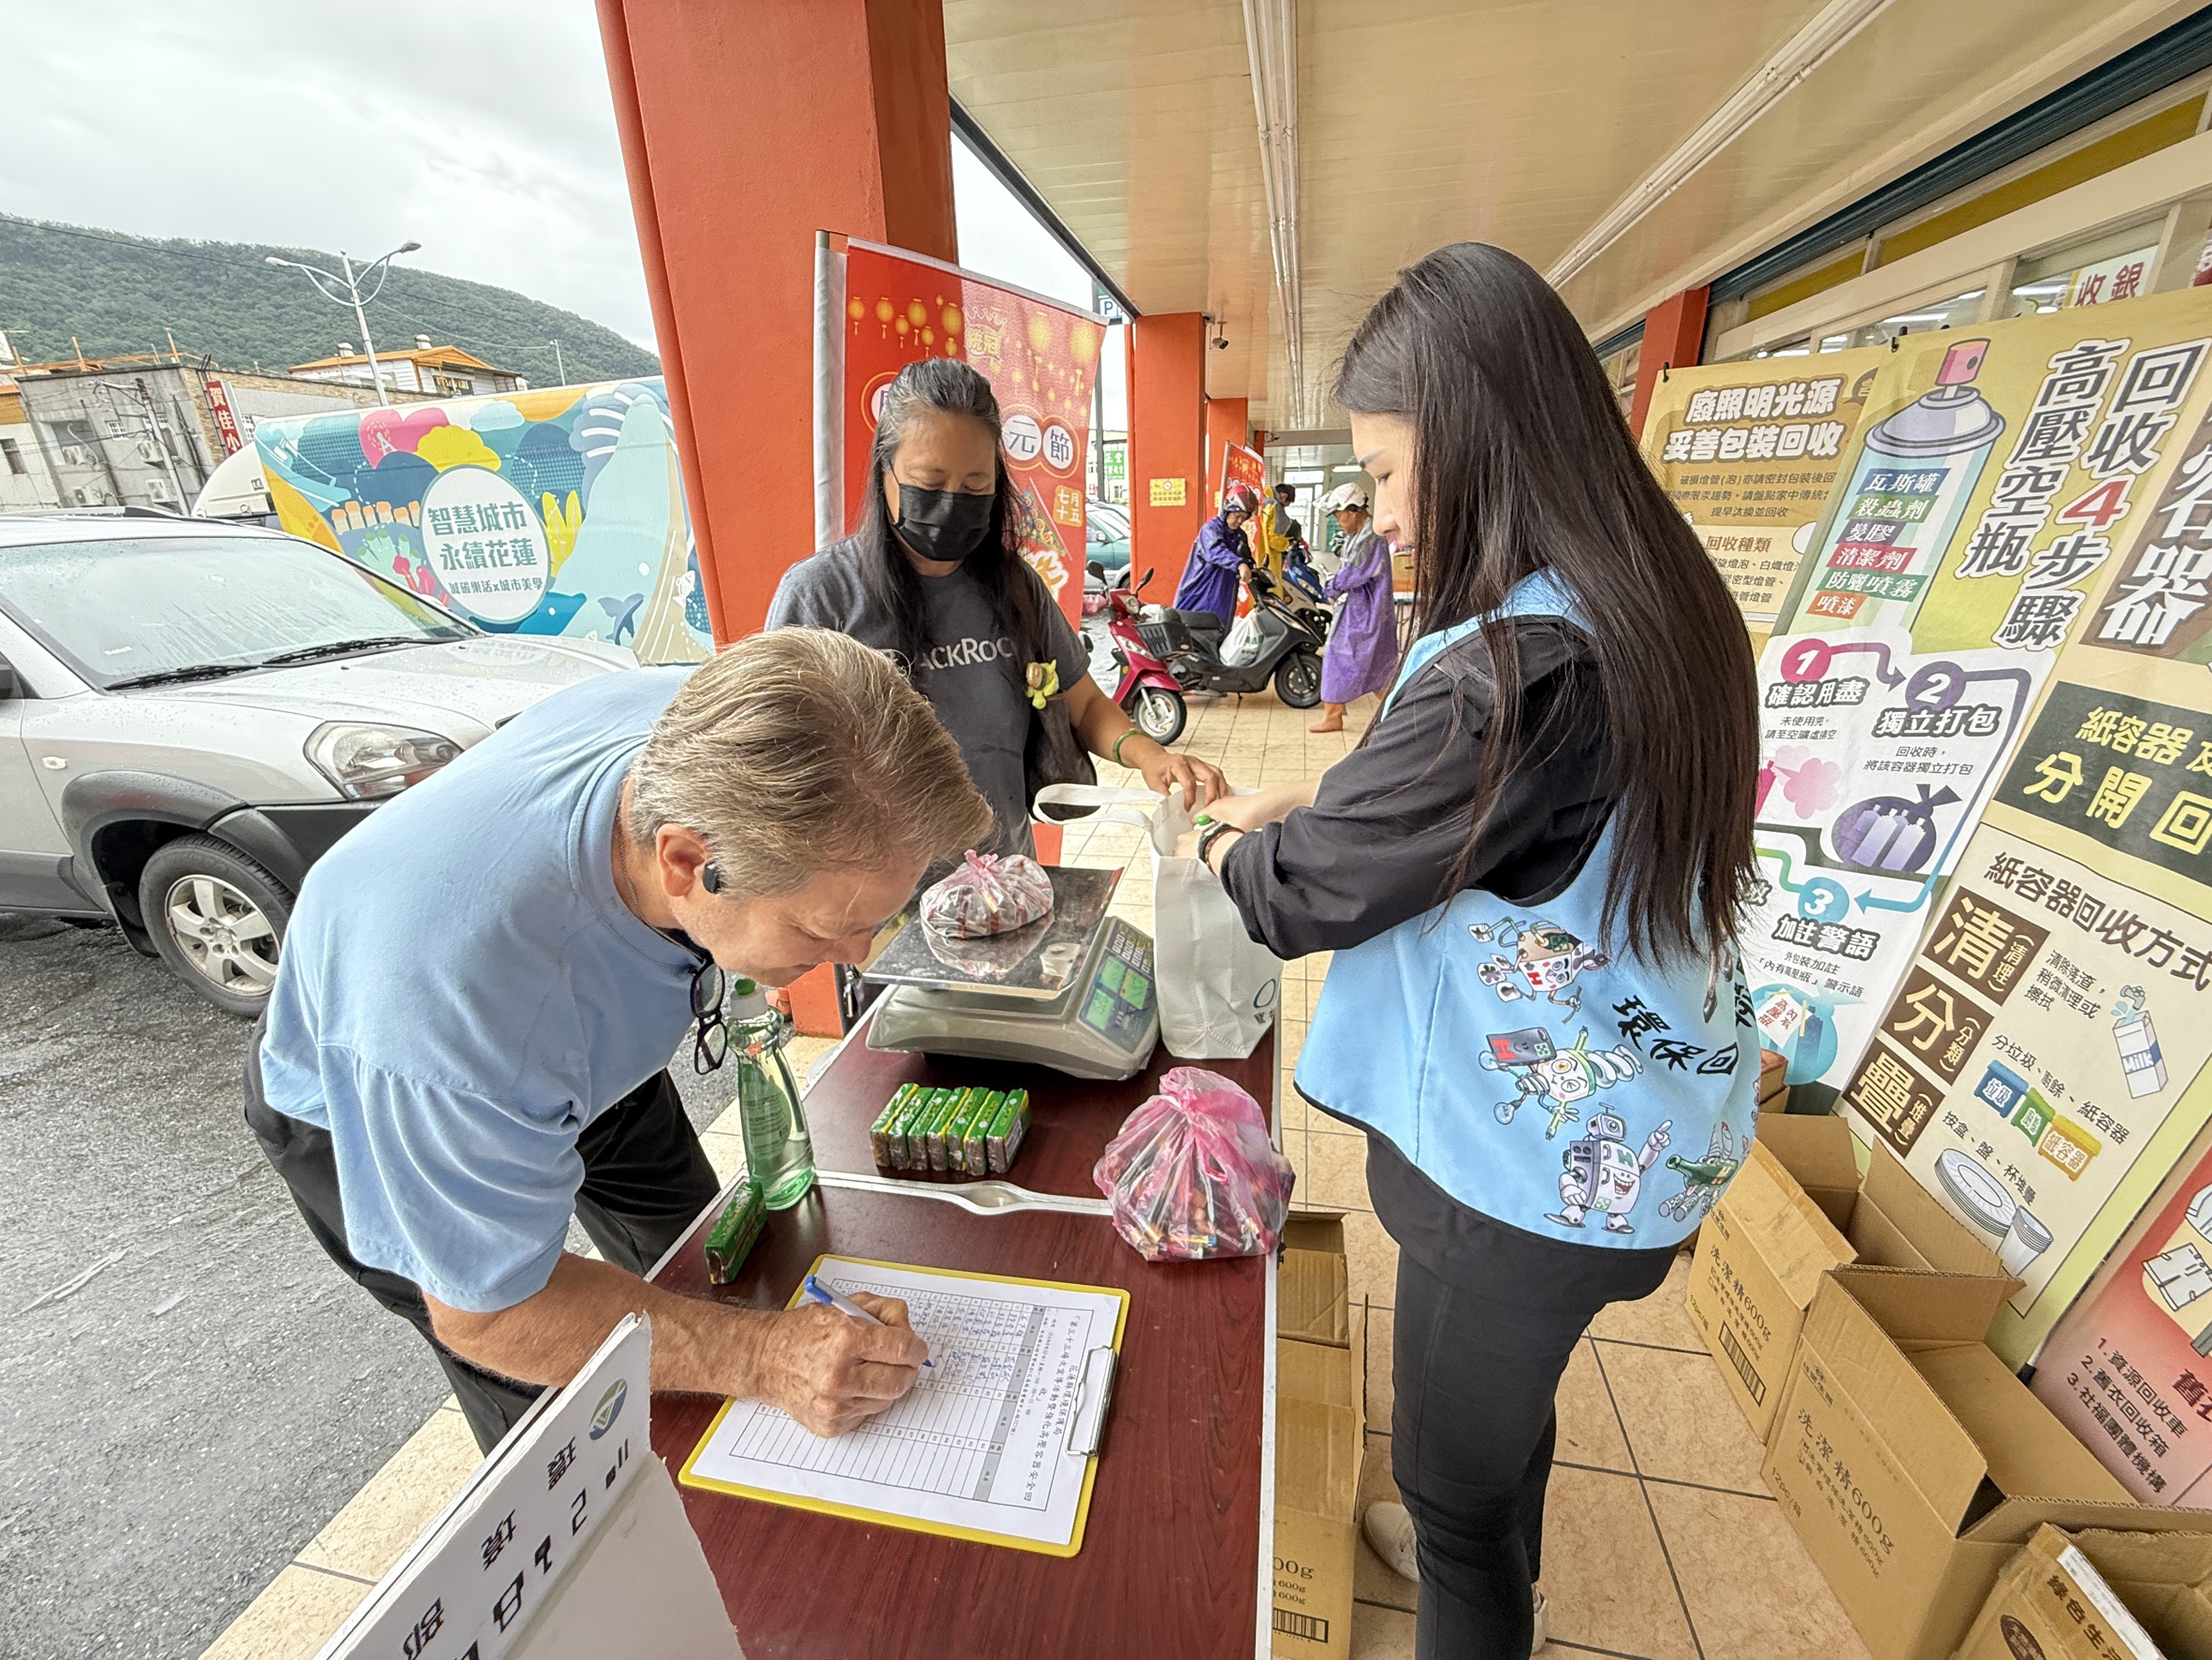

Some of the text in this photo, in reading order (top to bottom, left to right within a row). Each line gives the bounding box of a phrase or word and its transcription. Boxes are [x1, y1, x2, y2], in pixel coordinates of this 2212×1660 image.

[1104, 301, 1113, 315] P
[1685, 379, 1841, 422] 廢照明光源
[209, 386, 241, 451] 賀佳小
[1663, 422, 1845, 461] 妥善包裝回收
[1959, 339, 2130, 576] 高壓空瓶
[1864, 473, 1941, 494] 瓦斯罐
[2001, 341, 2205, 648] 回收4步驟
[428, 502, 528, 536] 智慧城市
[1855, 497, 1931, 520] 殺蟲劑
[1706, 535, 1772, 553] 回收種類
[1845, 522, 1896, 543] 髮膠
[440, 537, 538, 571] 永續花蓮
[1835, 546, 1909, 571] 清潔劑
[1825, 571, 1918, 598] 防曬噴霧
[1814, 594, 1857, 616] 噴漆
[1796, 649, 1820, 676] 1
[1767, 679, 1866, 706] 確認用盡
[1914, 673, 1952, 705] 2
[1875, 706, 2001, 735] 獨立打包
[1863, 760, 1973, 776] 將該容器獨立打包
[2022, 750, 2212, 855] 分開回
[1803, 888, 1834, 915] 3
[1983, 852, 2212, 992] 紙容器回收方式
[1774, 916, 1878, 960] 加註警語
[1933, 896, 2016, 980] 清
[1783, 951, 1841, 976] 外包裝加註
[2023, 983, 2055, 1012] 擦拭
[1893, 983, 1956, 1051] 分
[2124, 1051, 2155, 1074] Milk
[1850, 1051, 1914, 1134] 疊
[1985, 1077, 2014, 1107] 垃圾
[2042, 1132, 2088, 1172] 紙容器
[1797, 1407, 1895, 1555] 洗潔精600g
